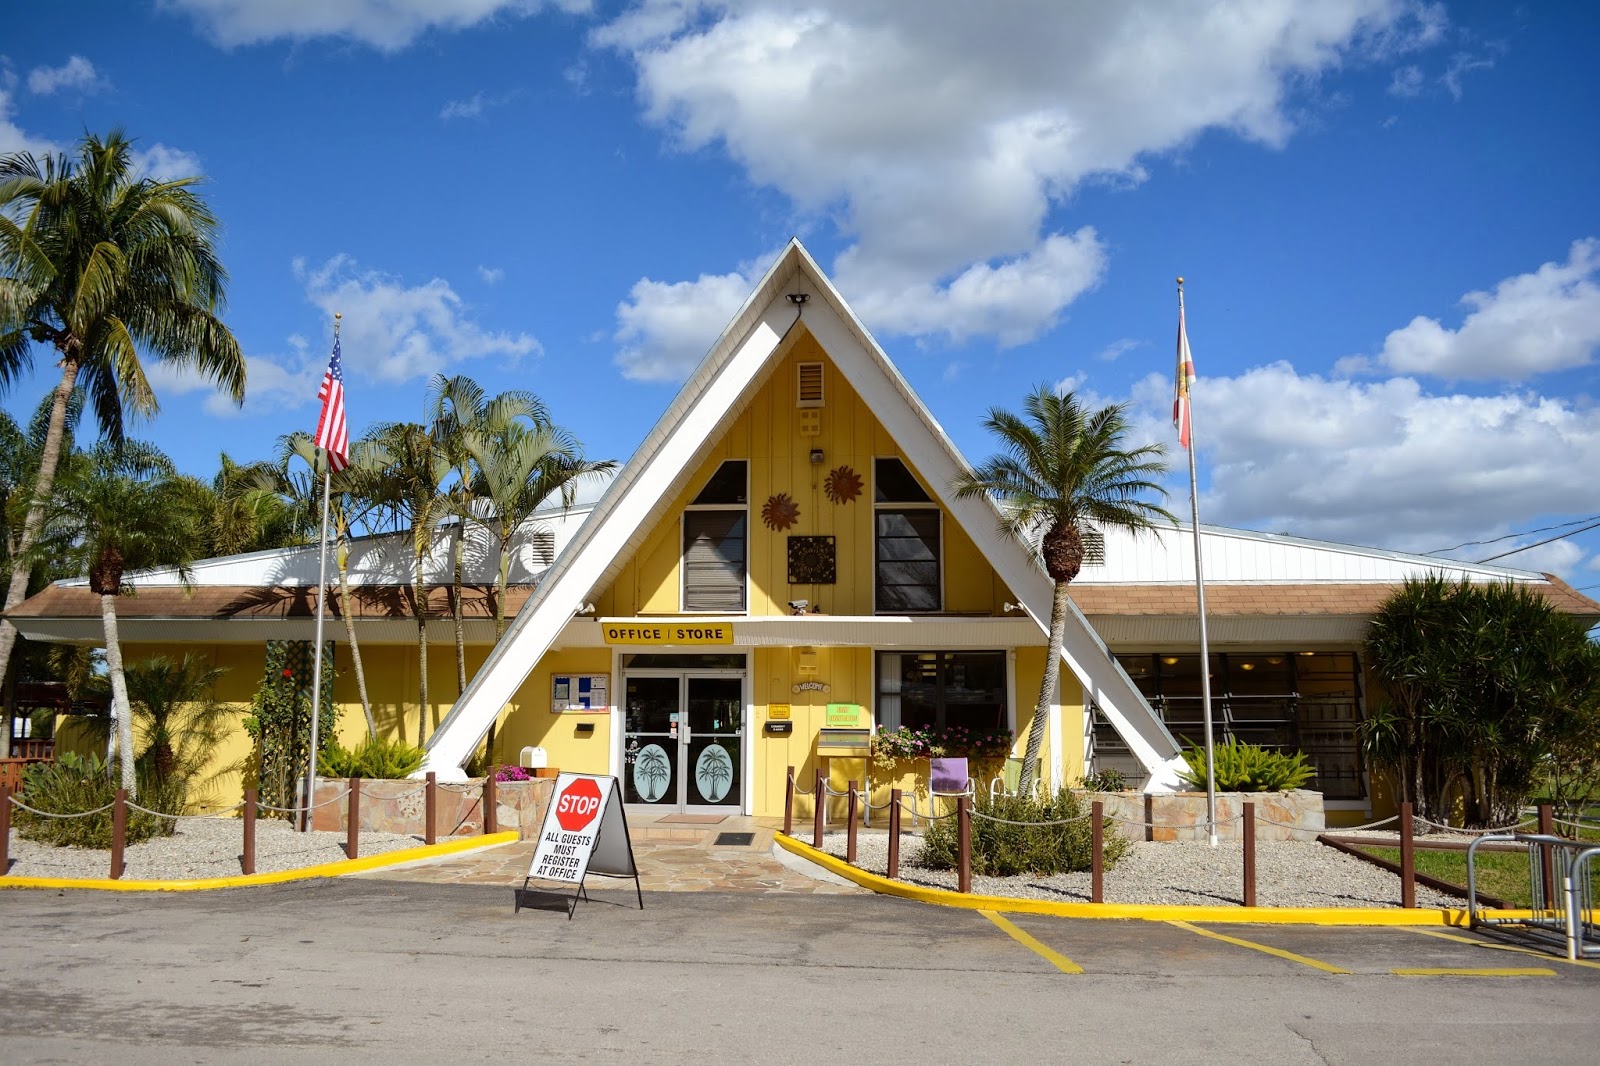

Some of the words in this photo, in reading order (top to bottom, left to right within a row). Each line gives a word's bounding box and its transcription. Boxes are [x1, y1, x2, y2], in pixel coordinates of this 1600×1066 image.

[608, 629, 661, 639] OFFICE
[676, 629, 723, 639] STORE
[799, 682, 823, 690] WELCOME
[559, 794, 598, 815] STOP
[545, 832, 559, 842] ALL
[561, 833, 591, 846] GUESTS
[553, 844, 576, 855] MUST
[542, 854, 580, 867] REGISTER
[537, 865, 548, 875] AT
[549, 866, 577, 879] OFFICE
